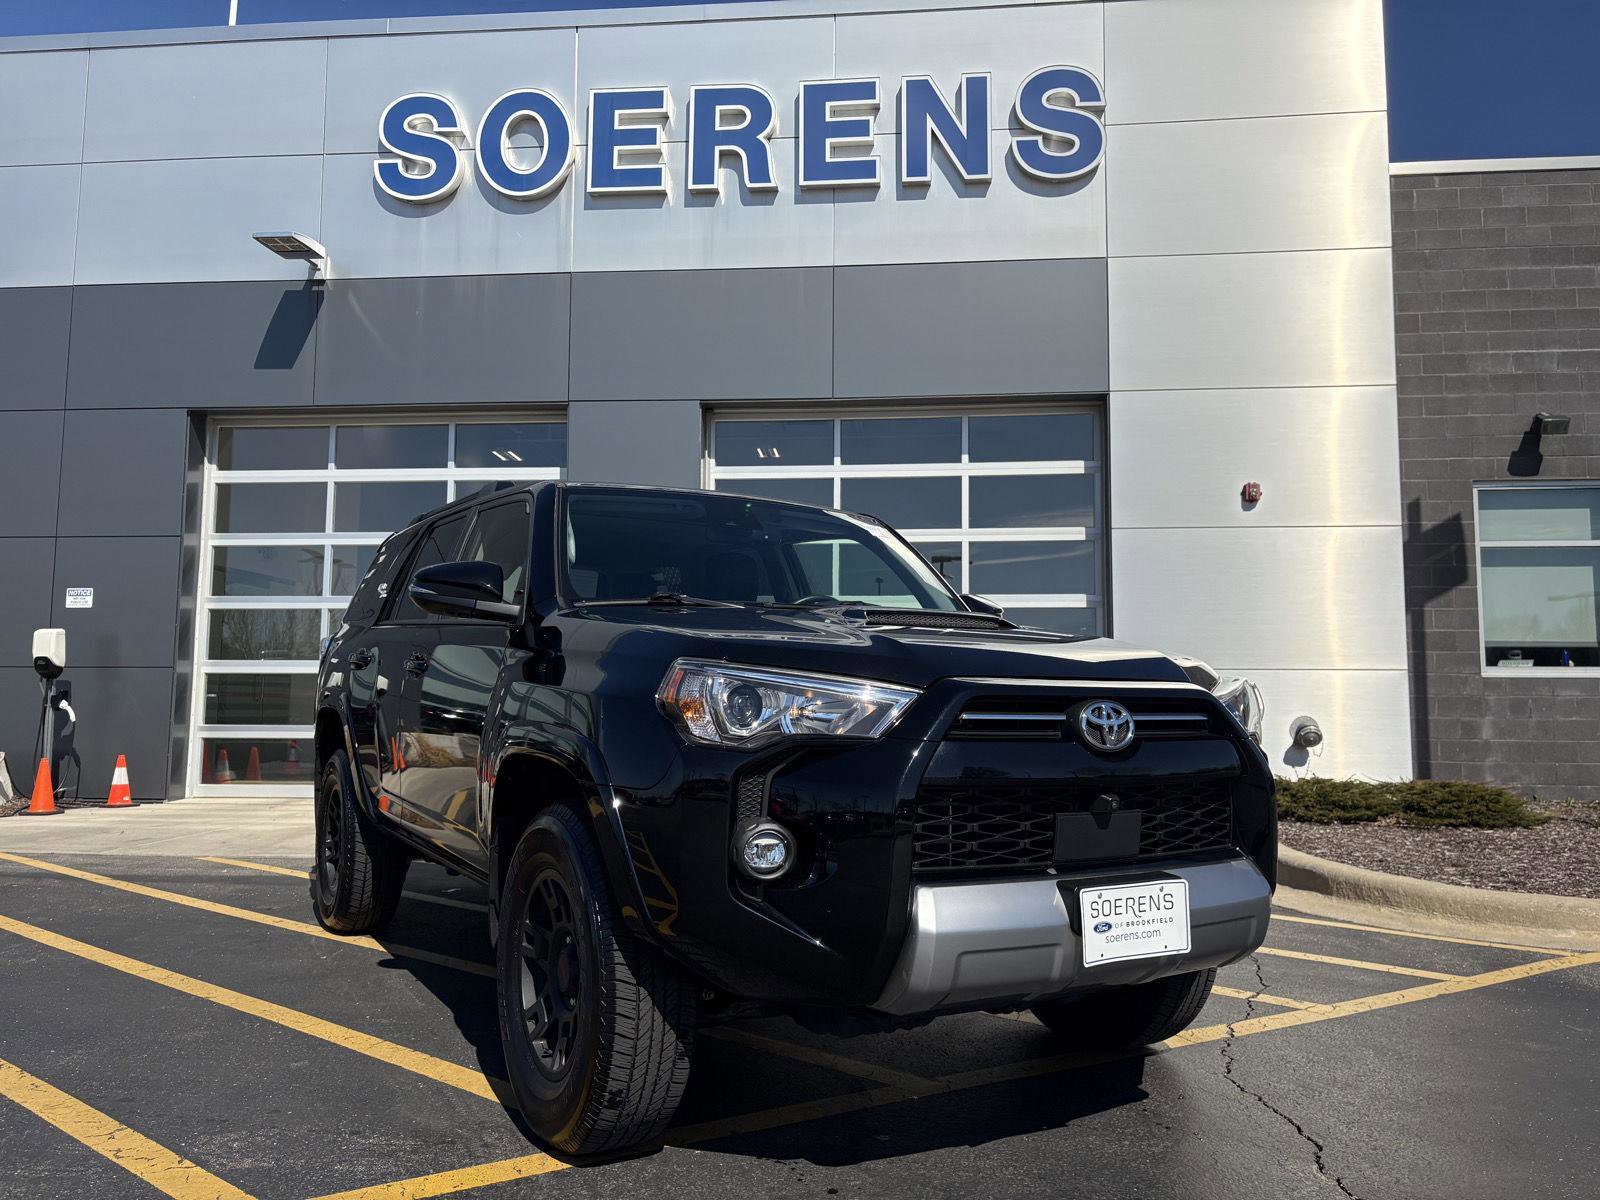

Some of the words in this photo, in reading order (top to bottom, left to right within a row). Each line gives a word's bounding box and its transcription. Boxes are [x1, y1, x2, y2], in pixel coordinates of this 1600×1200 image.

[373, 66, 1106, 203] SOERENS
[1090, 893, 1174, 918] SOERENS
[1126, 917, 1174, 928] BROOKFIELD
[1105, 929, 1161, 944] soerens.com
